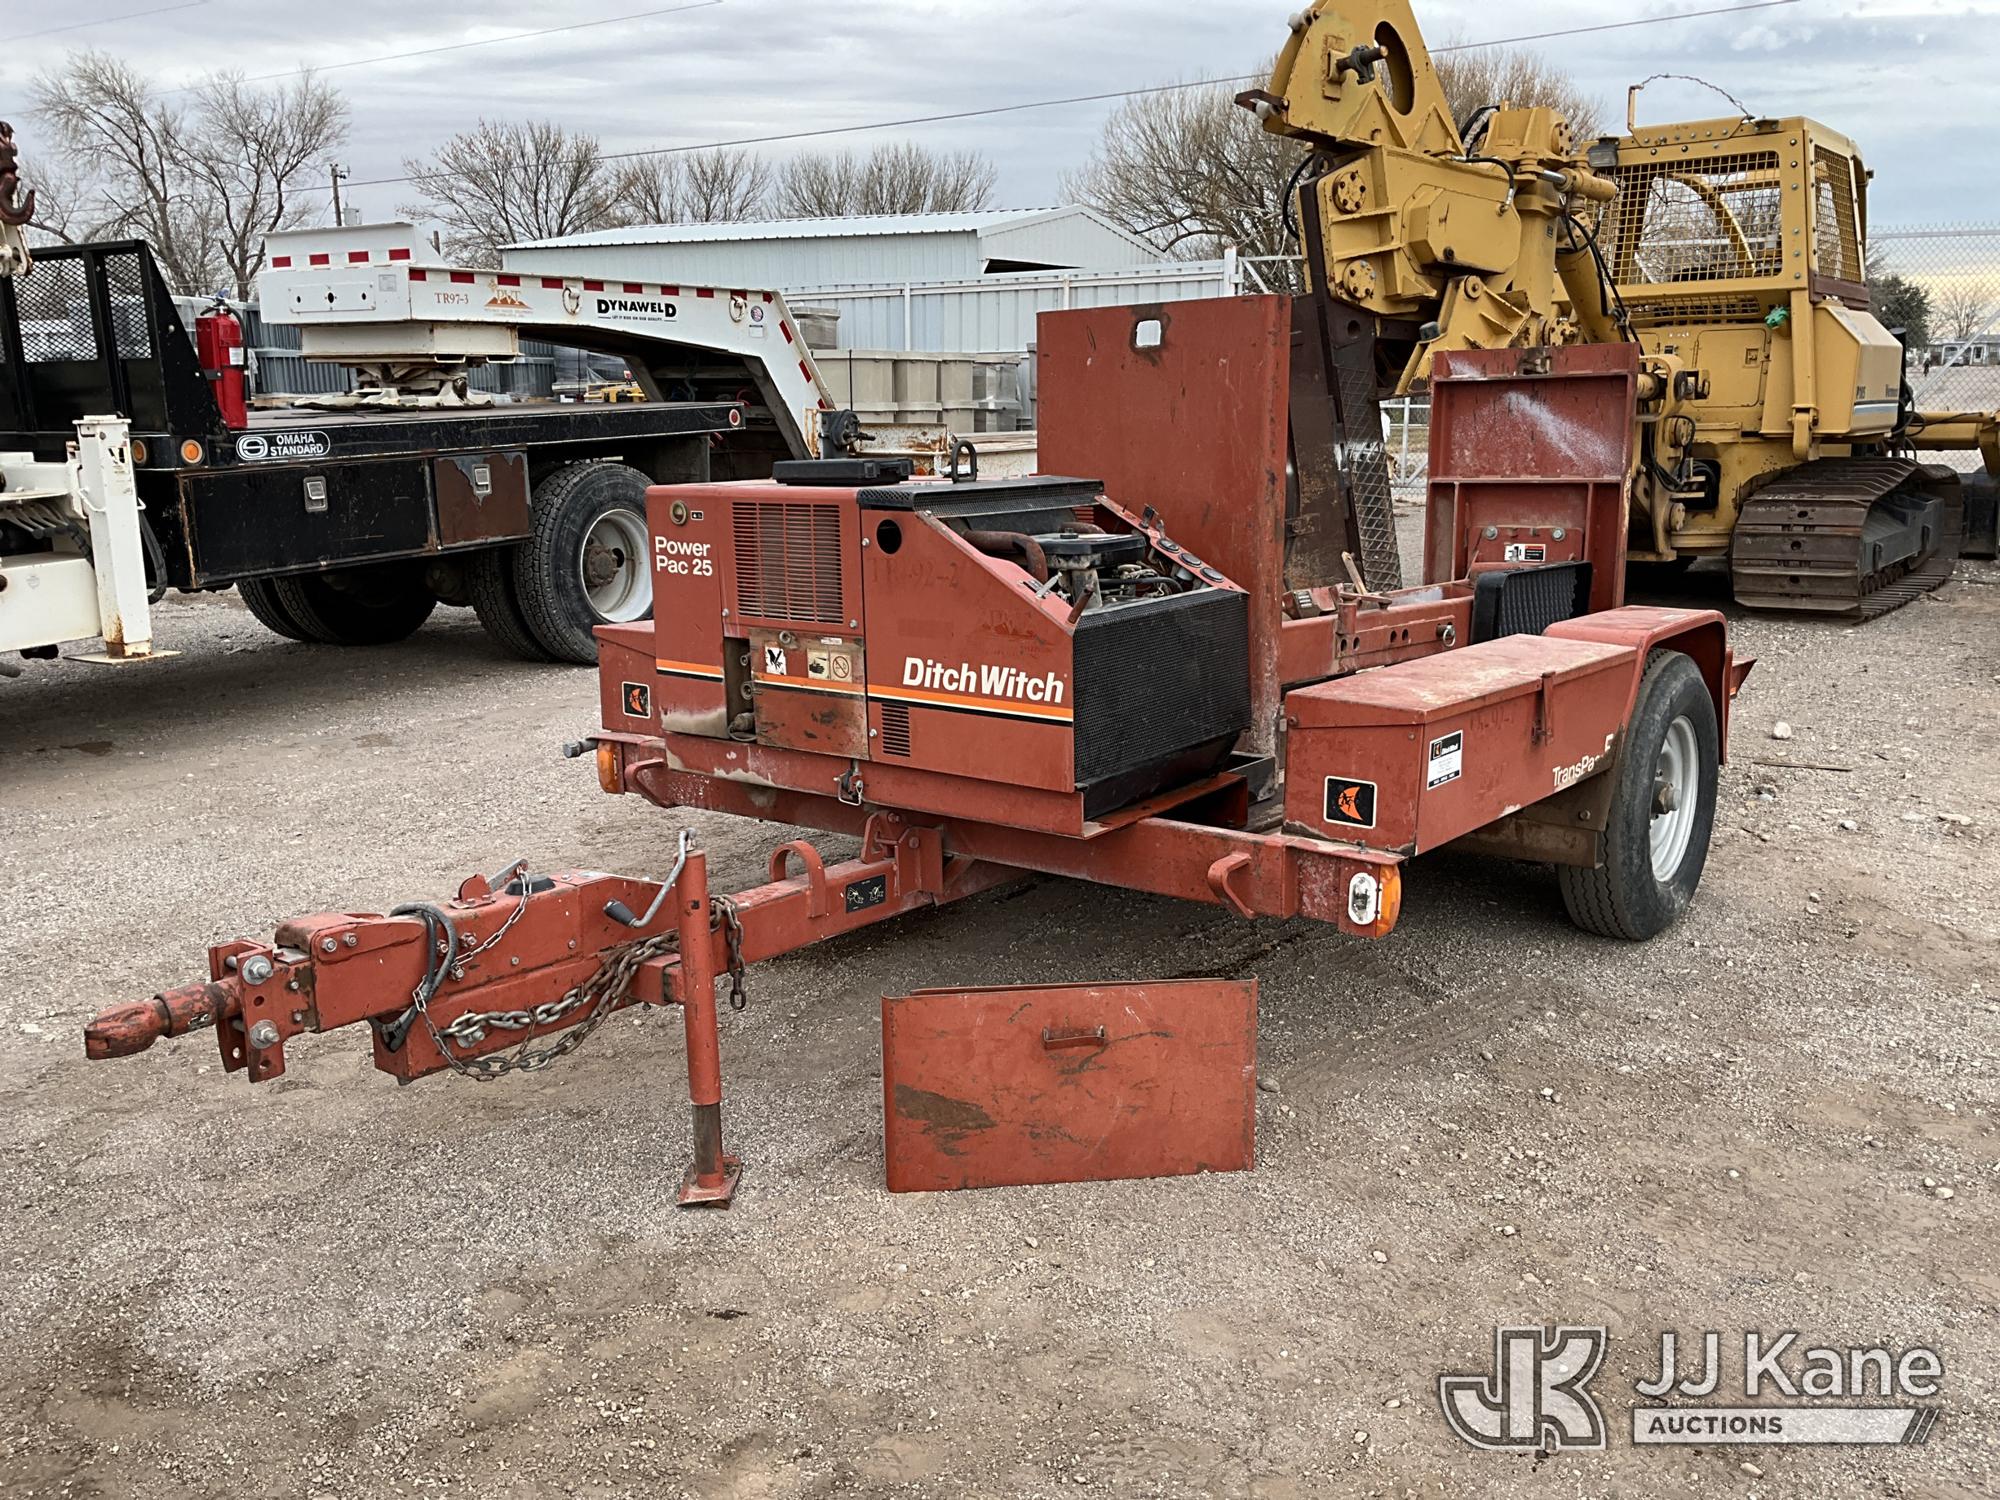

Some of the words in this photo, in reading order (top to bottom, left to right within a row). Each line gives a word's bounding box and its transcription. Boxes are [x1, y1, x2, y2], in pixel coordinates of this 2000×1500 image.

[434, 292, 469, 304] TR97-3
[597, 299, 677, 318] DYNAWELD
[276, 433, 315, 446] OMAHA
[270, 443, 323, 456] STANDARD
[654, 535, 711, 557] Power
[655, 554, 689, 575] Pac
[692, 558, 713, 576] 25
[902, 656, 977, 693] Ditch
[980, 664, 1064, 704] Witch
